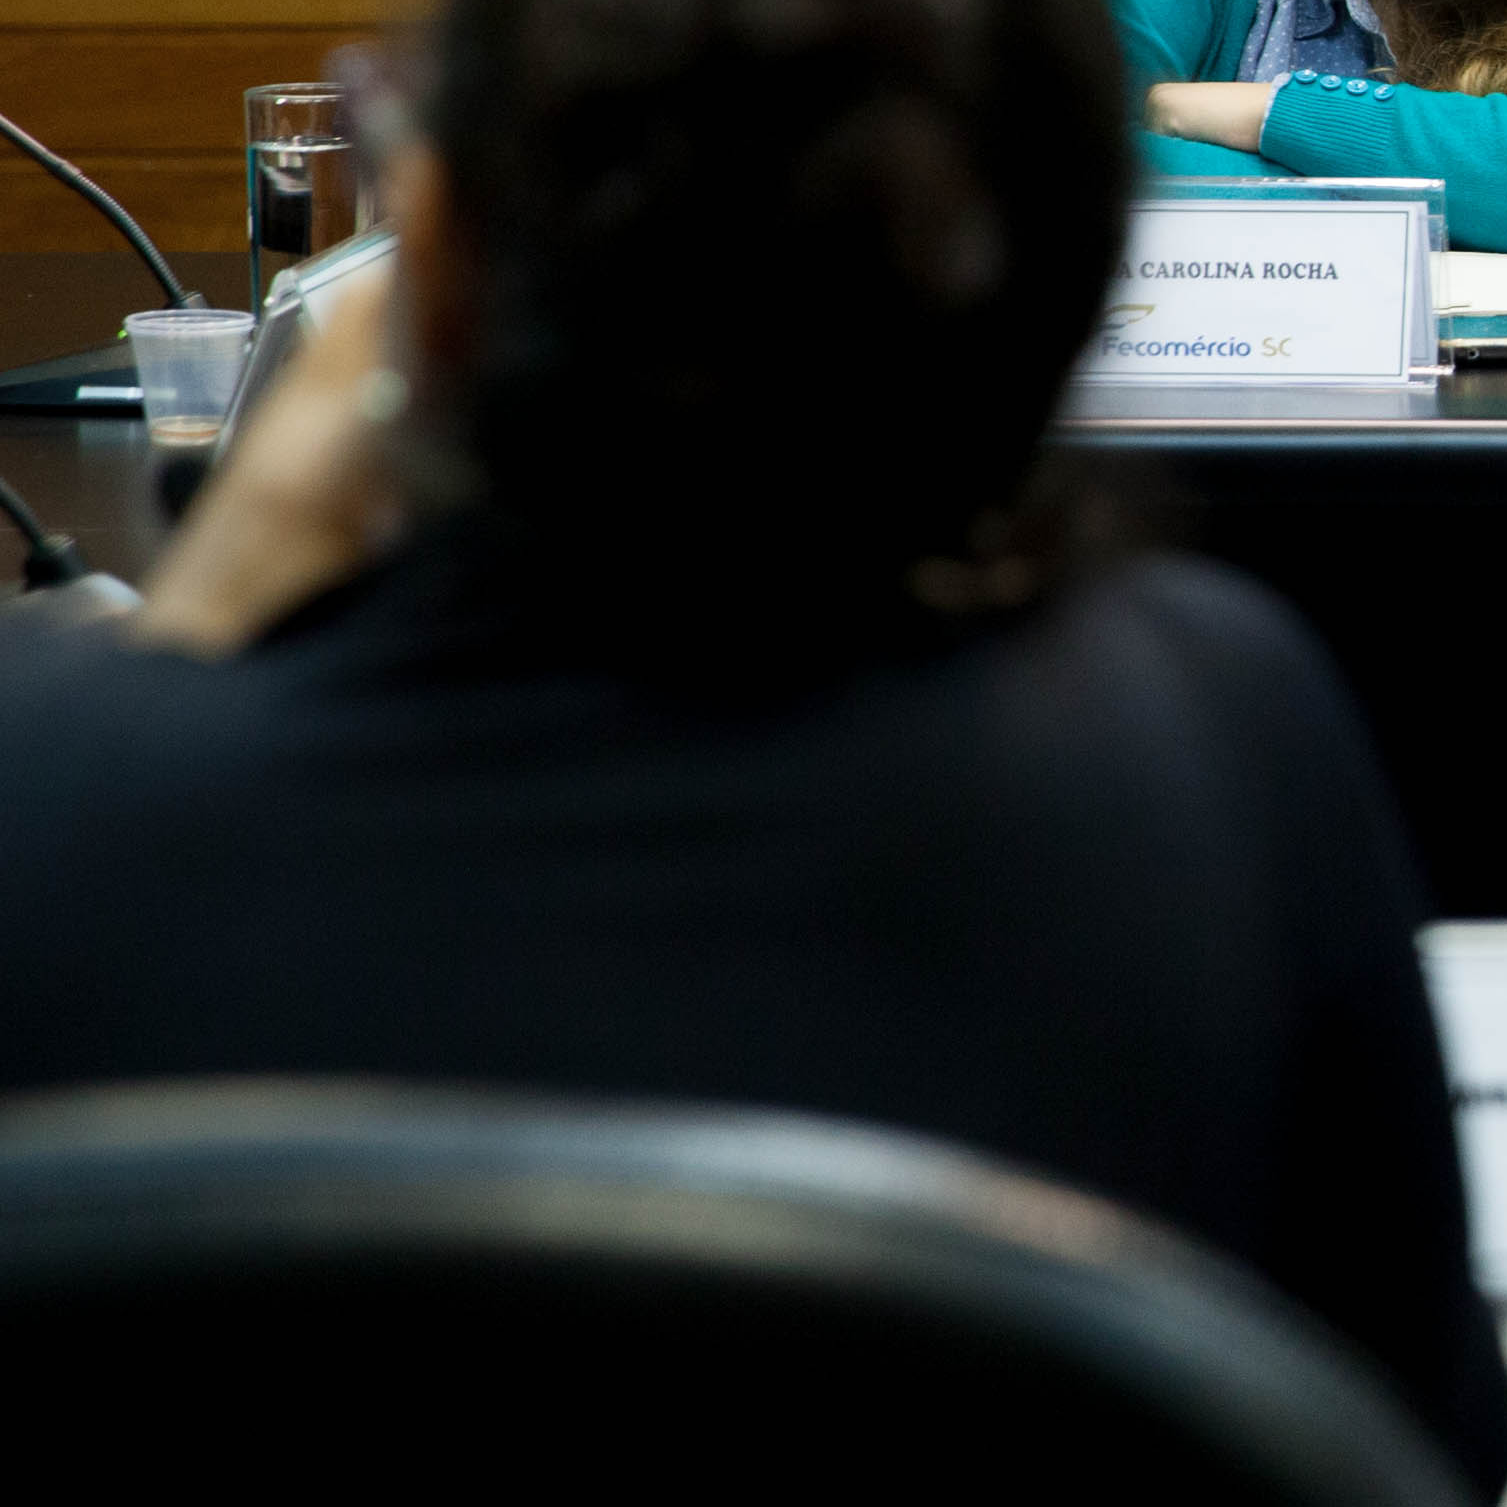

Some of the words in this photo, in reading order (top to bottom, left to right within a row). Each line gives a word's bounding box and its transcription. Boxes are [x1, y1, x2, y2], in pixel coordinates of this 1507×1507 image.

[1139, 261, 1254, 280] CAROLINA
[1262, 261, 1339, 280] ROCHA
[1102, 335, 1252, 357] Fecomércio
[1261, 336, 1293, 357] SC
